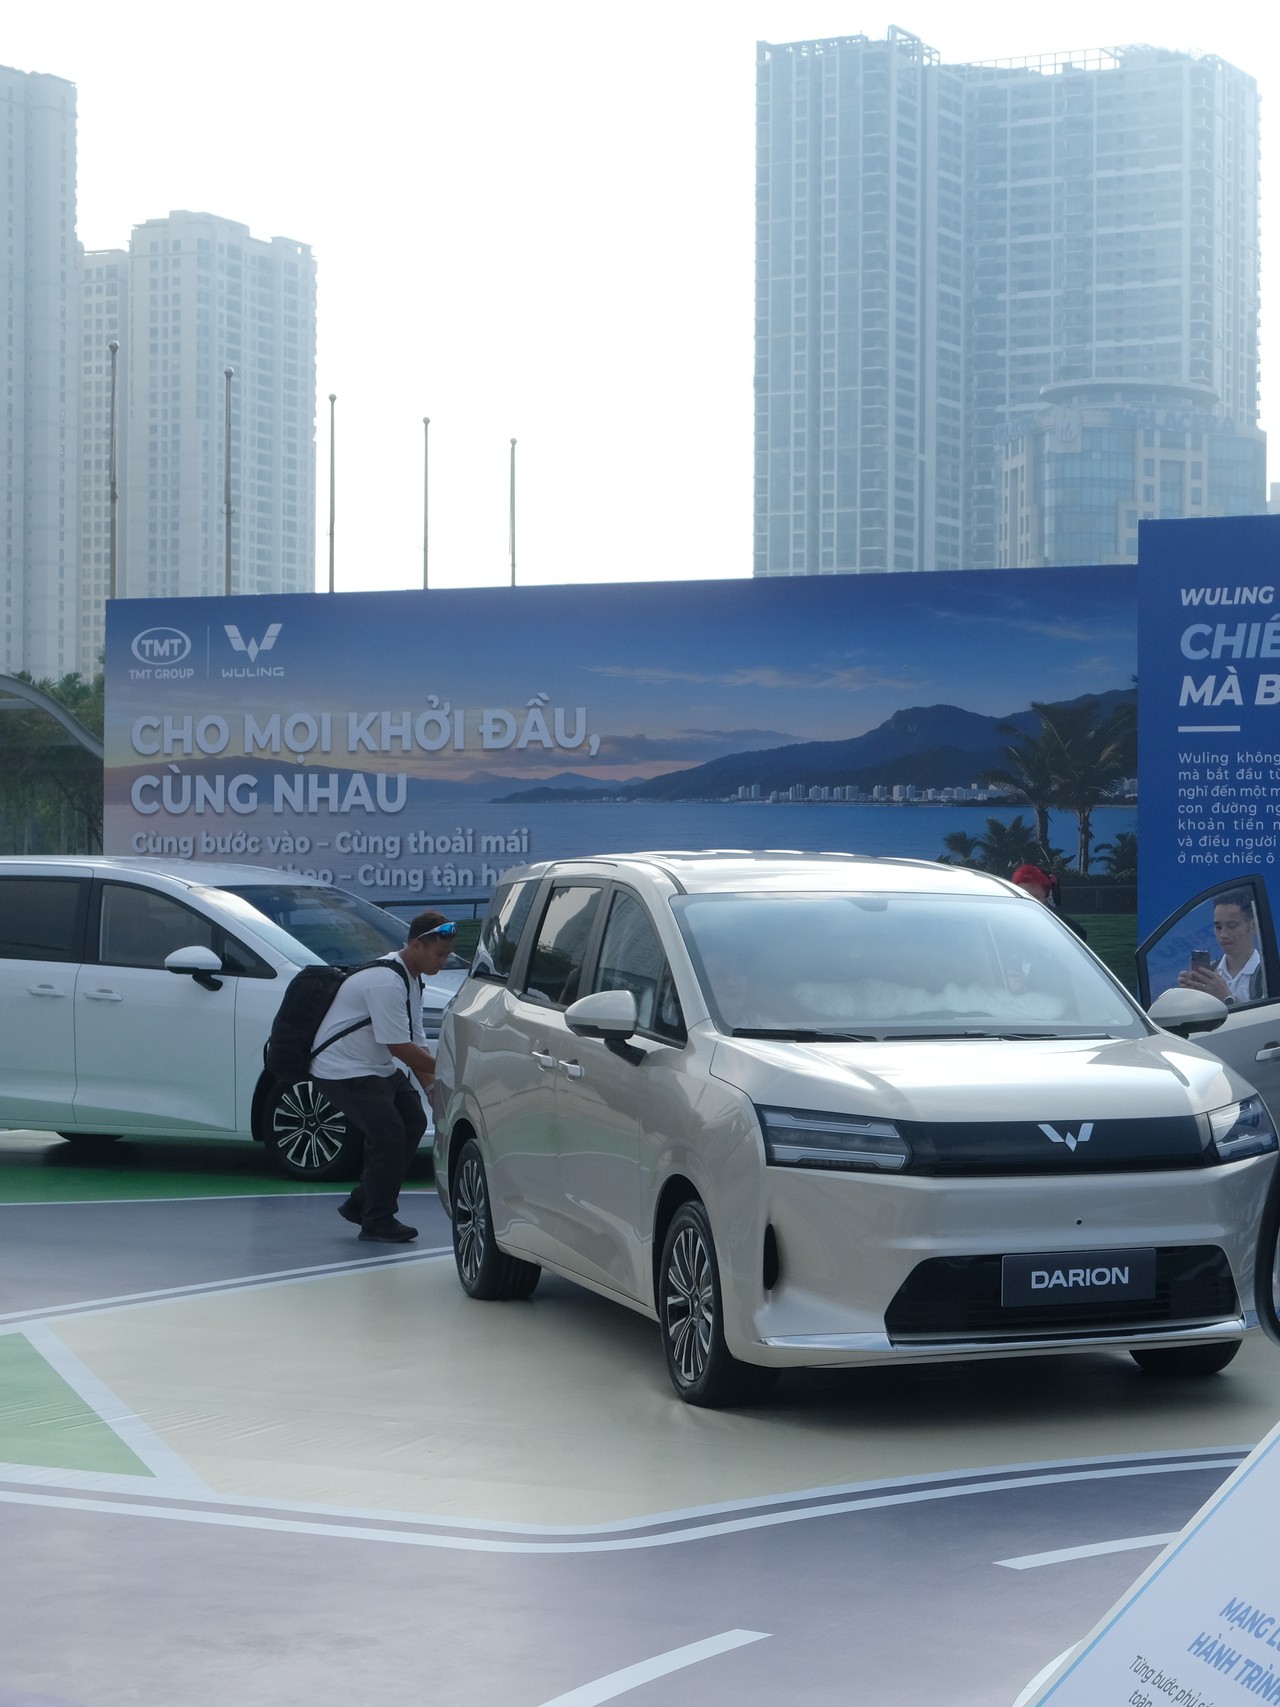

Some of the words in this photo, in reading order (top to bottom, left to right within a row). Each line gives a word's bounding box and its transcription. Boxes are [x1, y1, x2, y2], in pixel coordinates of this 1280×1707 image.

[1181, 586, 1275, 606] WULING
[142, 639, 182, 657] TMT
[129, 669, 152, 679] TMT
[155, 668, 194, 679] GROUP
[222, 667, 284, 678] WULING
[1179, 666, 1244, 706] MÀ
[131, 713, 231, 757] CHO
[245, 711, 332, 765] MỌI
[348, 694, 465, 753] KHỞI
[479, 691, 600, 757] ĐẦU,
[1178, 752, 1229, 766] Wuling
[1178, 768, 1200, 780] mà
[1206, 768, 1229, 780] bắt
[1236, 767, 1262, 780] đầu
[131, 764, 258, 814] CÙNG
[273, 772, 408, 813] NHAU
[1178, 784, 1209, 799] nghĩ
[1211, 783, 1236, 797] đến
[1240, 785, 1267, 799] một
[1178, 804, 1203, 814] con
[1211, 801, 1257, 816] đường
[1178, 817, 1225, 830] khoản
[1233, 817, 1264, 830] tiền
[132, 831, 194, 858] Cùng
[202, 831, 260, 853] bước
[267, 830, 311, 853] vào
[335, 830, 401, 858] Cùng
[408, 827, 473, 853] thoải
[481, 828, 529, 853] mái
[1178, 836, 1193, 847] và
[1198, 834, 1230, 847] điều
[1235, 835, 1277, 849] người
[1178, 852, 1186, 863] ở
[1191, 853, 1219, 866] một
[1224, 851, 1262, 864] chiếc
[1266, 852, 1275, 863] ô
[358, 863, 424, 892] Cùng
[431, 864, 474, 892] tận
[1031, 1266, 1129, 1290] DARION
[1218, 1596, 1276, 1638] MẠNG
[1187, 1631, 1243, 1675] HÀNH
[1129, 1655, 1156, 1684] Từng
[1152, 1670, 1179, 1697] bước
